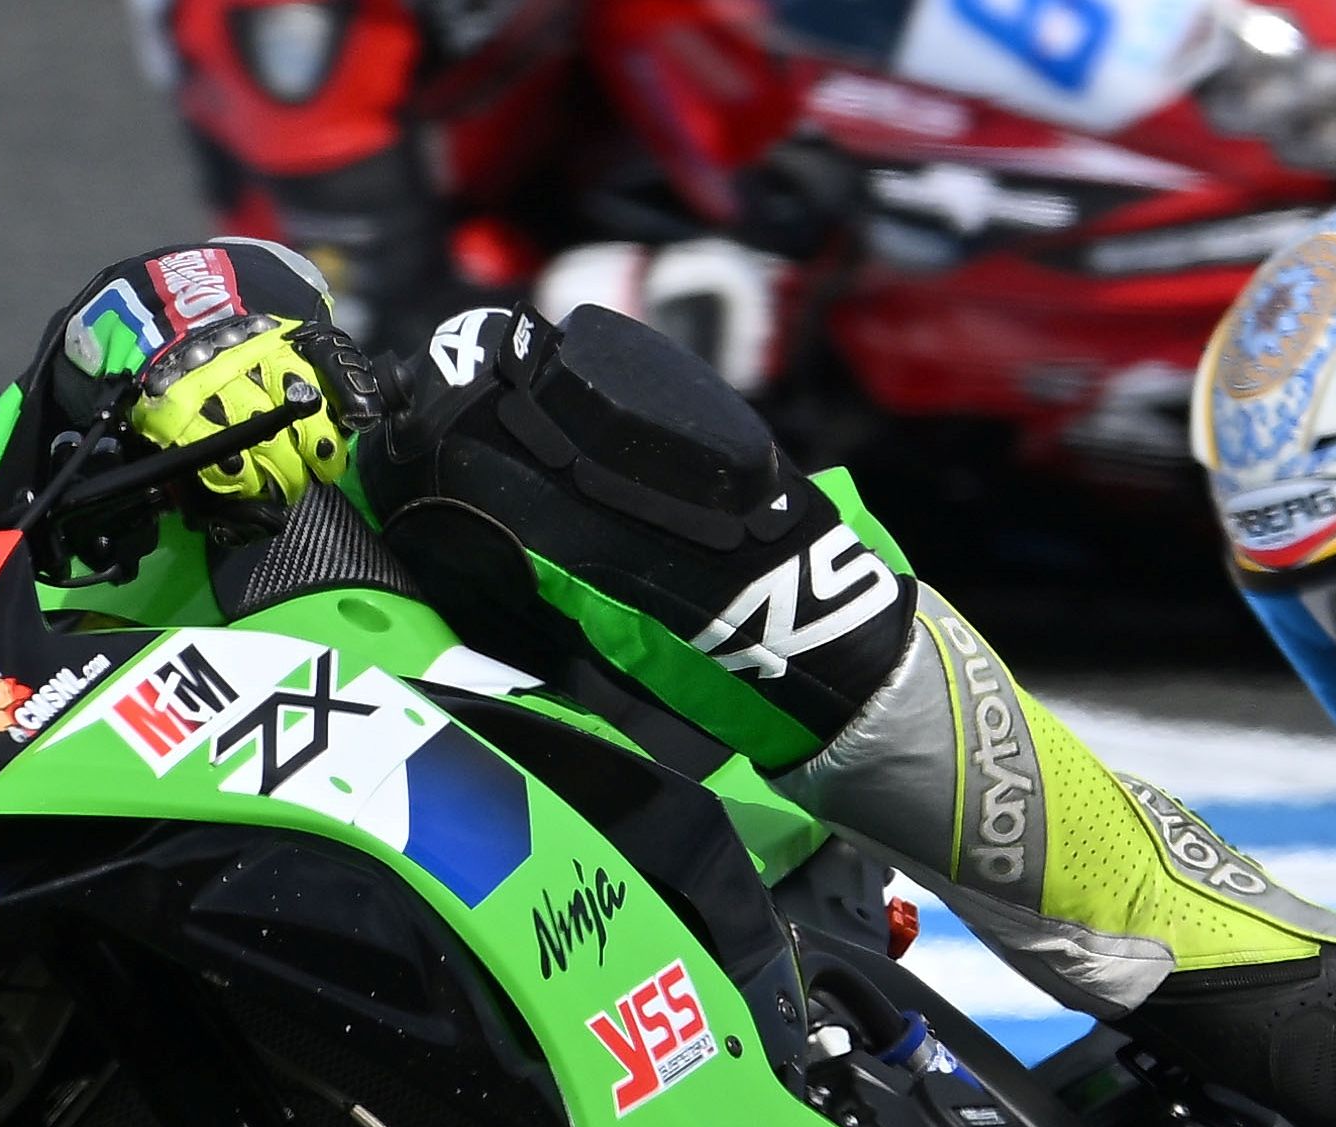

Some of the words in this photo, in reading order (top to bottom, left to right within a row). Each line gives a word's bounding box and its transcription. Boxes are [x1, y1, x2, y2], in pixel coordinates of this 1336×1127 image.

[216, 648, 381, 798] ZX
[945, 617, 1034, 884] daytona
[532, 859, 626, 980] Ninja
